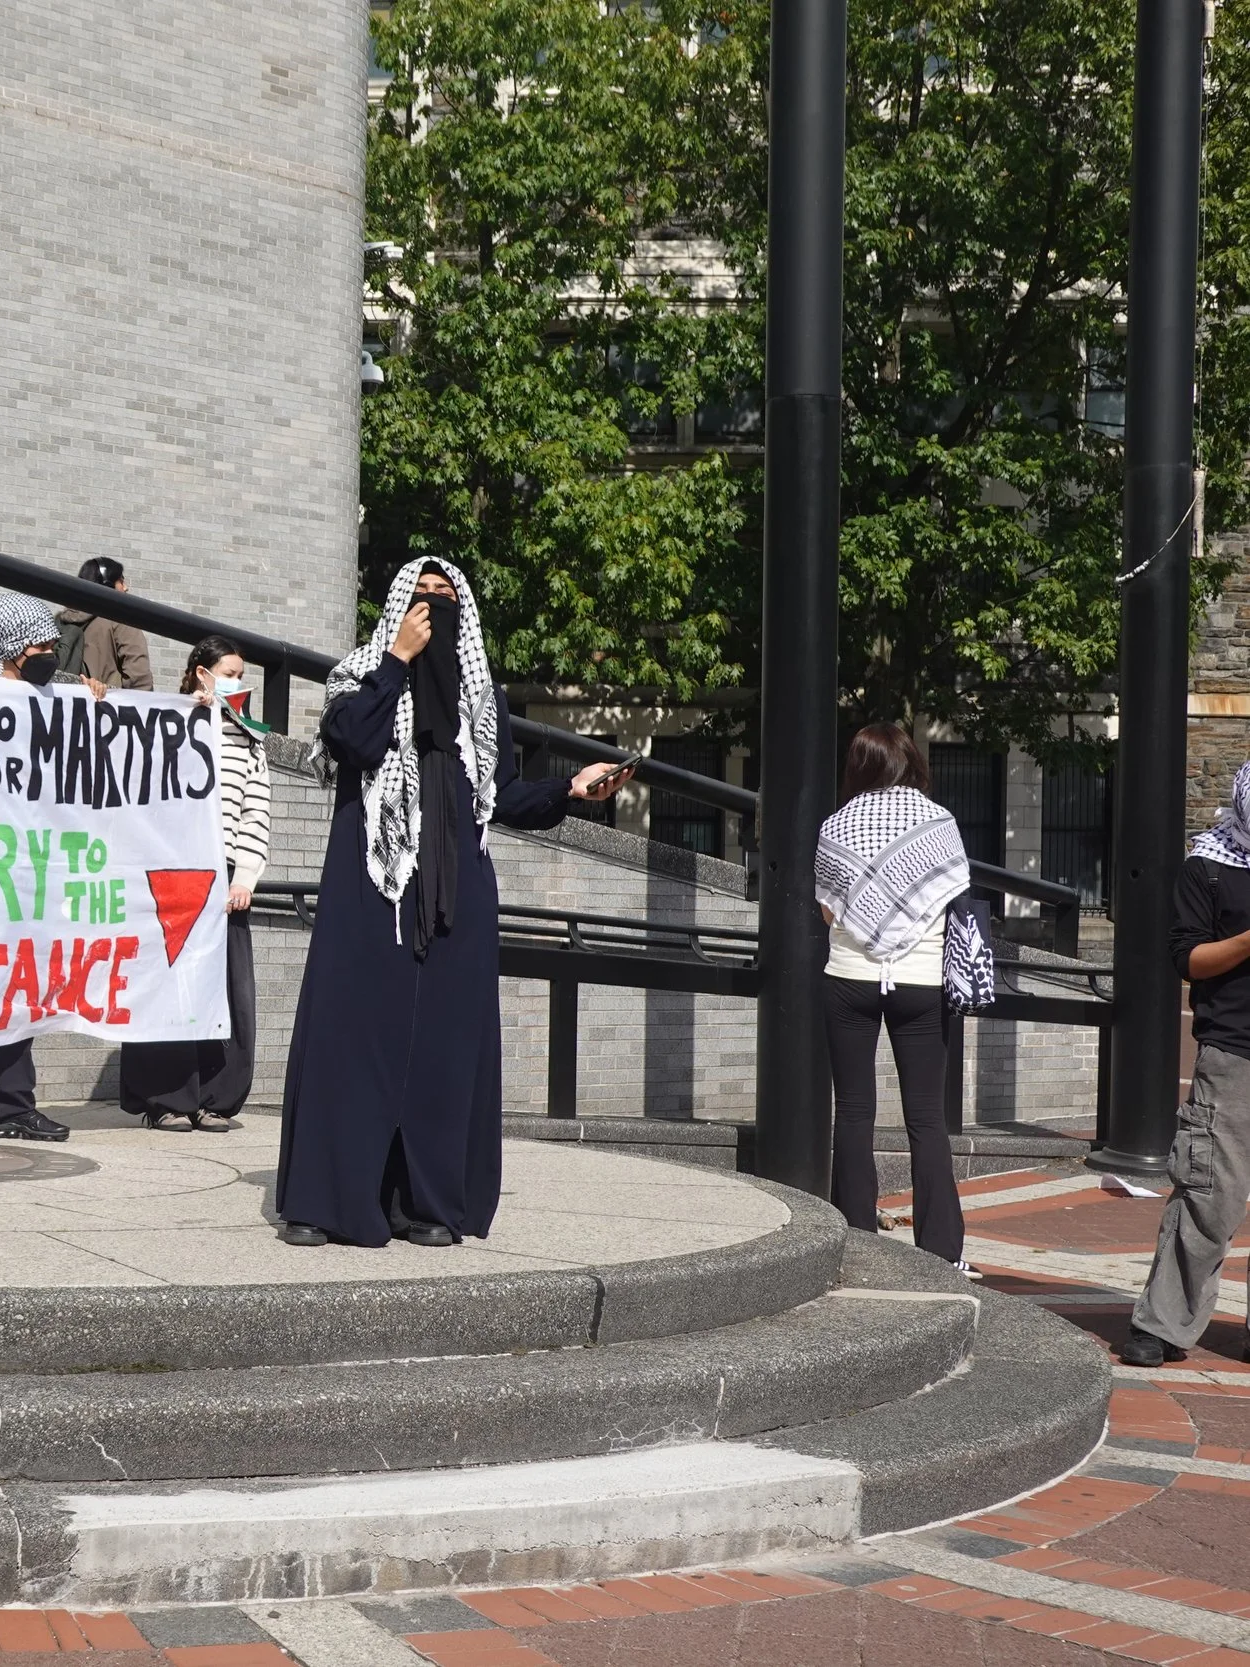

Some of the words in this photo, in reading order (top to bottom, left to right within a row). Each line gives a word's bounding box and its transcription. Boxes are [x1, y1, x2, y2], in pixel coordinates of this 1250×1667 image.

[27, 695, 216, 810] MARTYRS
[60, 831, 108, 874] TO
[63, 879, 127, 925] THE
